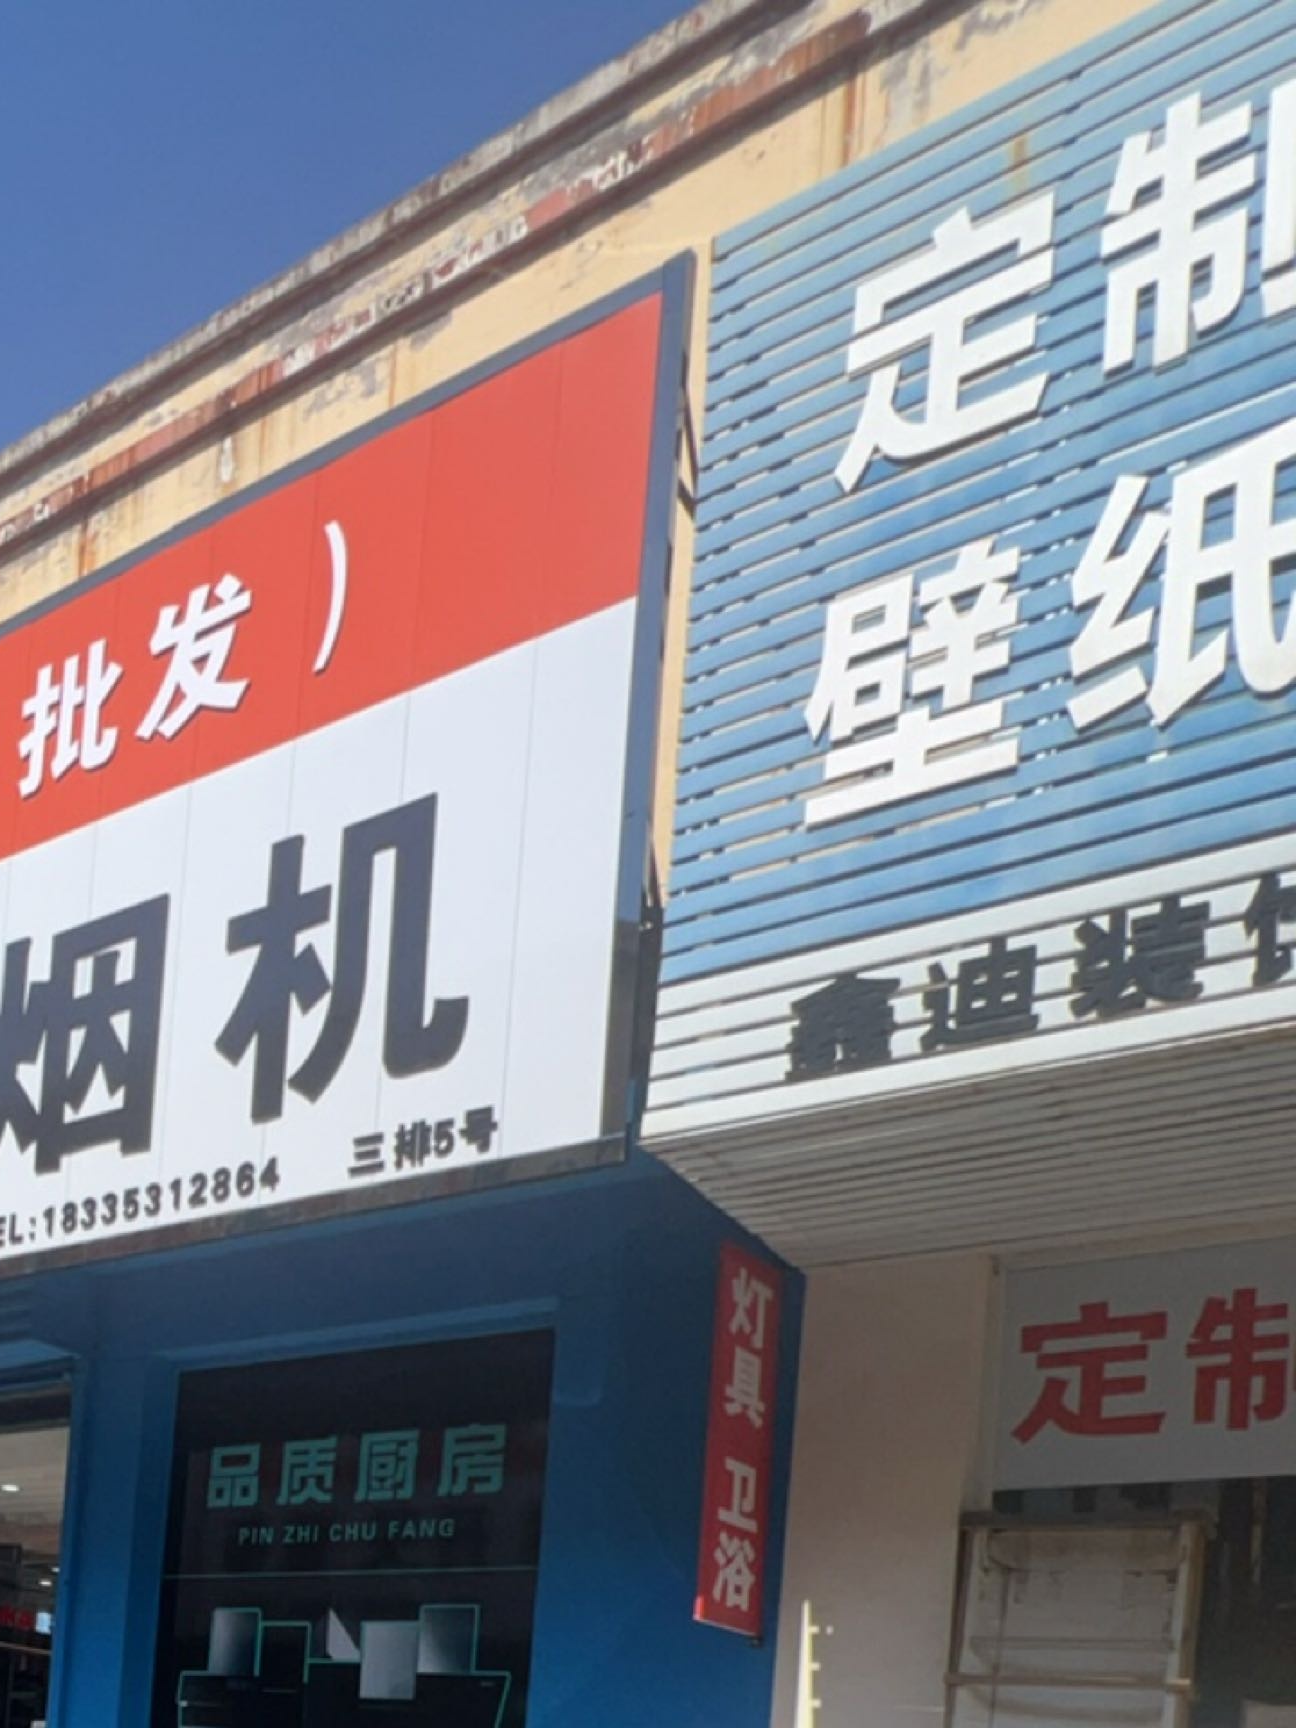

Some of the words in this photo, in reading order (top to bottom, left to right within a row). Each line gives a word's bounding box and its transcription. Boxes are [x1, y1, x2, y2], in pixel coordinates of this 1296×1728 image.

[834, 80, 1296, 495] 定制
[804, 417, 1296, 827] 壁纸
[348, 1107, 499, 1177] 三排5号
[729, 1267, 774, 1427] 灯具
[207, 1423, 508, 1508] 品质厨房
[238, 1527, 273, 1546] PIN
[282, 1523, 319, 1545] ZHI
[329, 1520, 377, 1542] CHU
[388, 1517, 456, 1539] FANG
[712, 1458, 758, 1612] 卫浴
